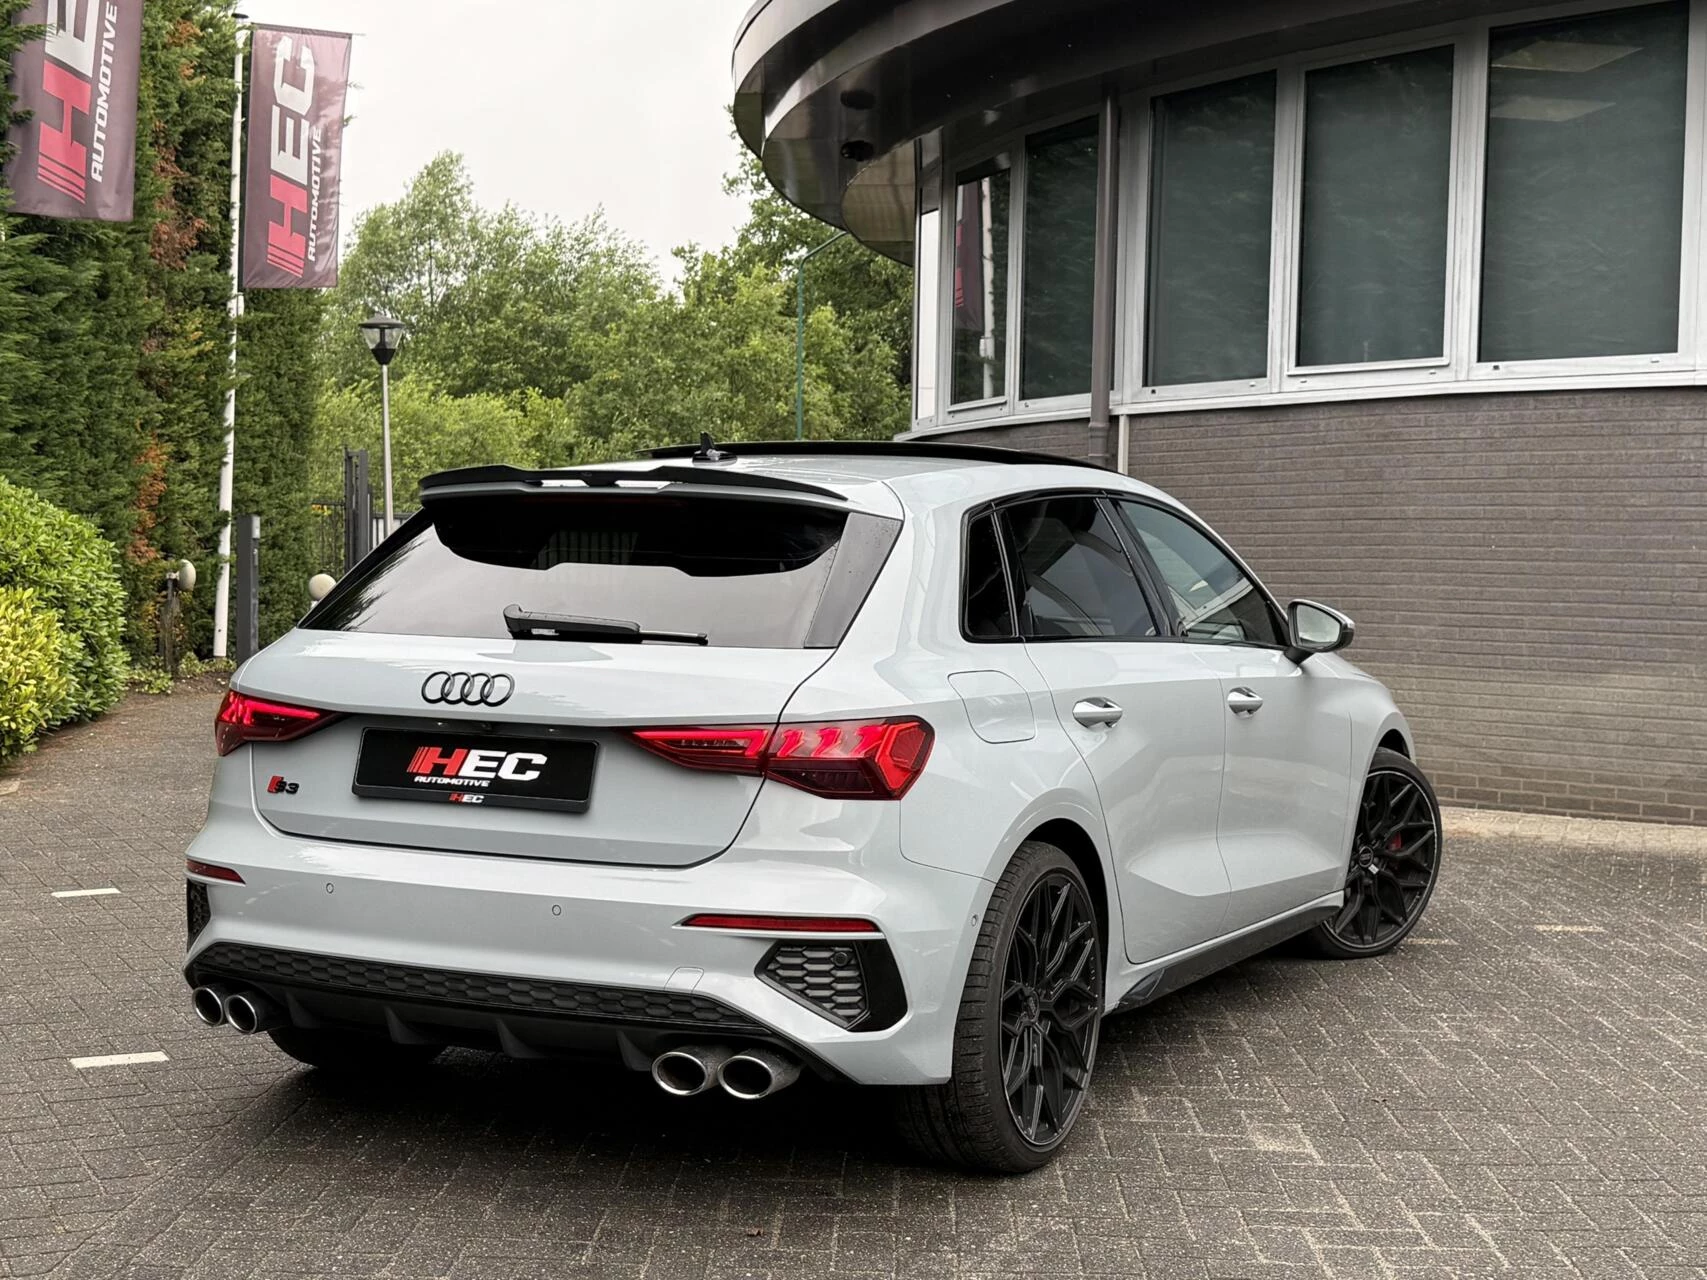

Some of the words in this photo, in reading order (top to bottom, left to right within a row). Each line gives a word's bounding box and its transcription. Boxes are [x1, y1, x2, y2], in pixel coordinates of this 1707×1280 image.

[90, 1, 118, 183] AUTOMOTIVE
[266, 35, 315, 279] HEC
[307, 126, 323, 263] AUTOMOTIVE
[406, 746, 548, 781] HEC
[413, 775, 490, 787] AUTOMOTIVE
[270, 777, 299, 795] S3
[449, 792, 485, 804] HEC
